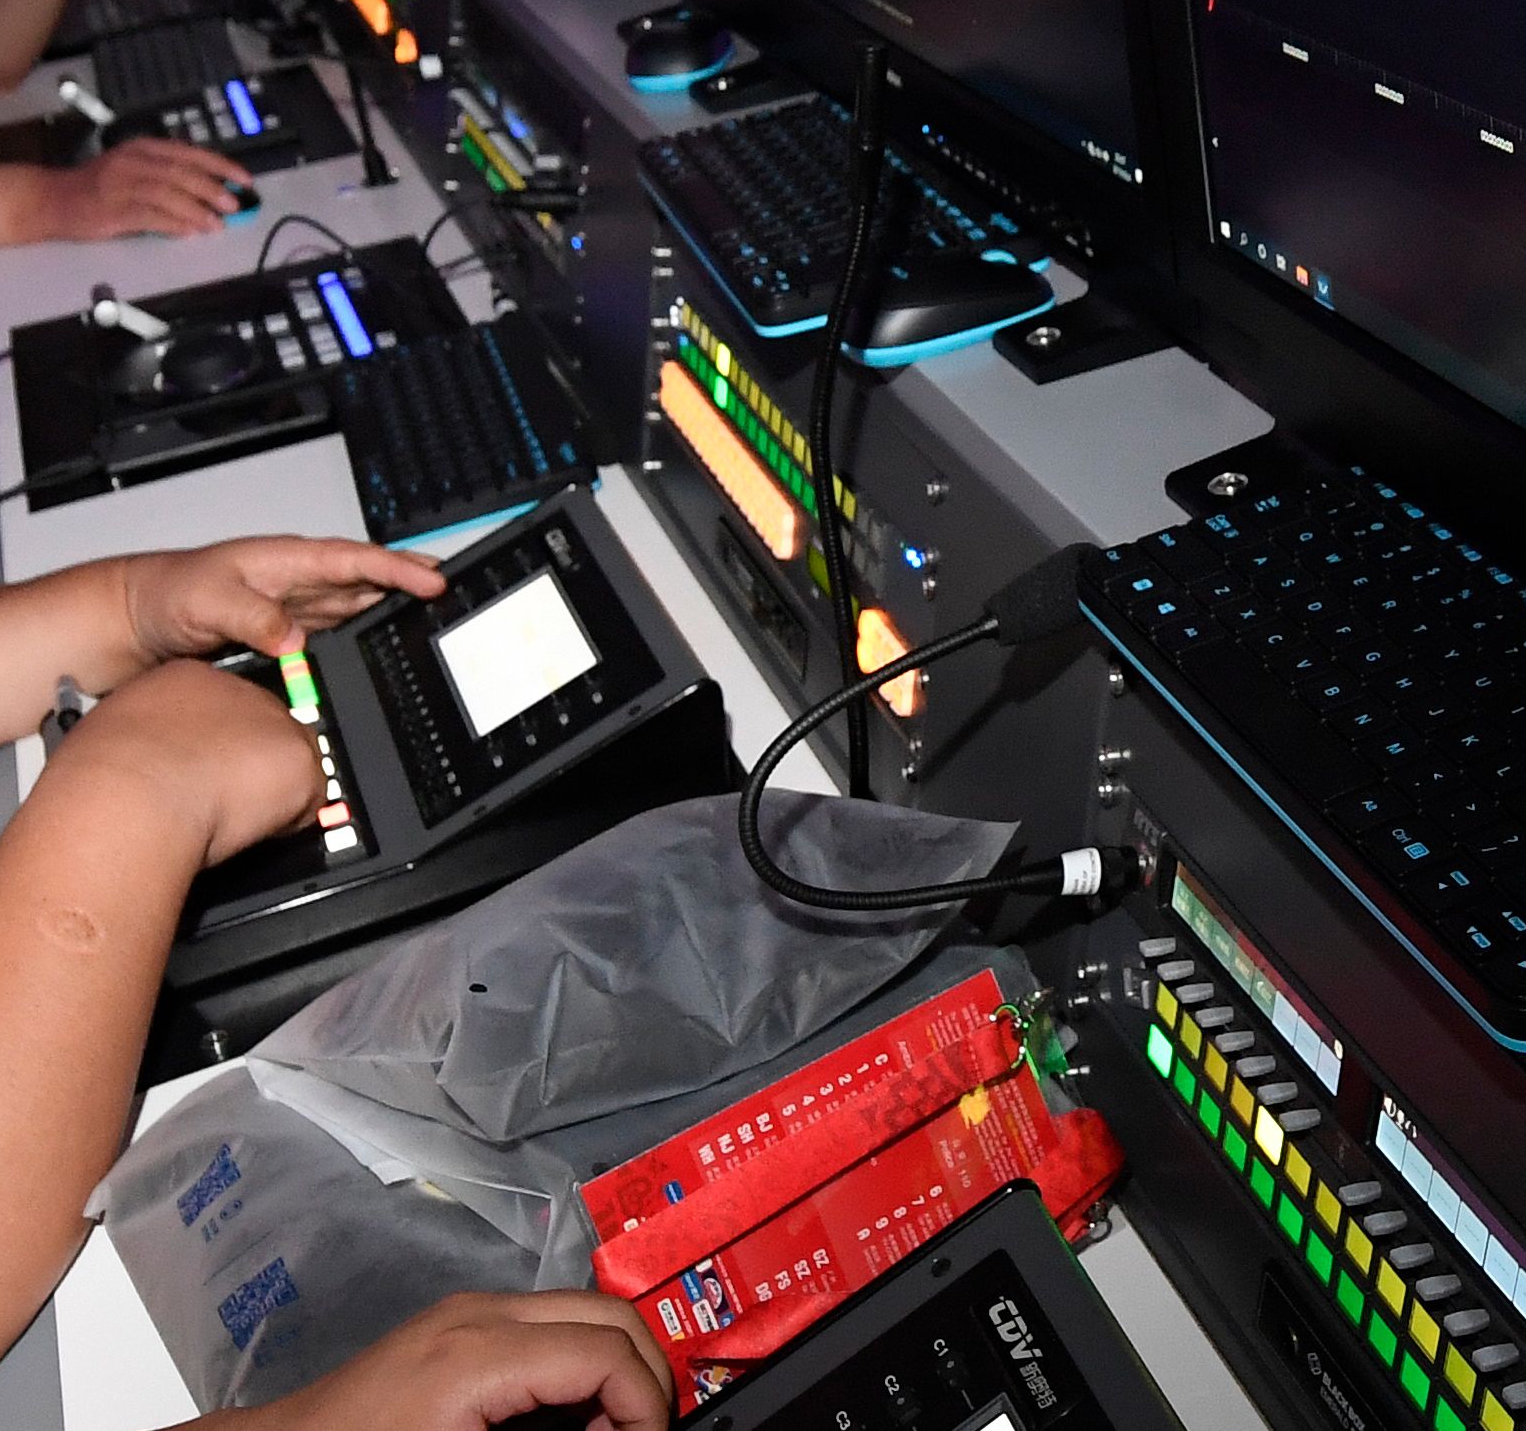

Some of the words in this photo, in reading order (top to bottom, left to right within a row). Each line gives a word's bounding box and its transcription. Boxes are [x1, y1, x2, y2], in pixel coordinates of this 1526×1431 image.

[819, 1081, 835, 1097] 3
[837, 1072, 853, 1087] 2
[781, 1102, 798, 1118] 5
[801, 1093, 816, 1107] 4
[736, 1122, 755, 1146] SH
[988, 1295, 1044, 1360] CDV
[932, 1337, 950, 1358] C1
[883, 1374, 900, 1396] C2
[834, 1410, 852, 1431] C3
